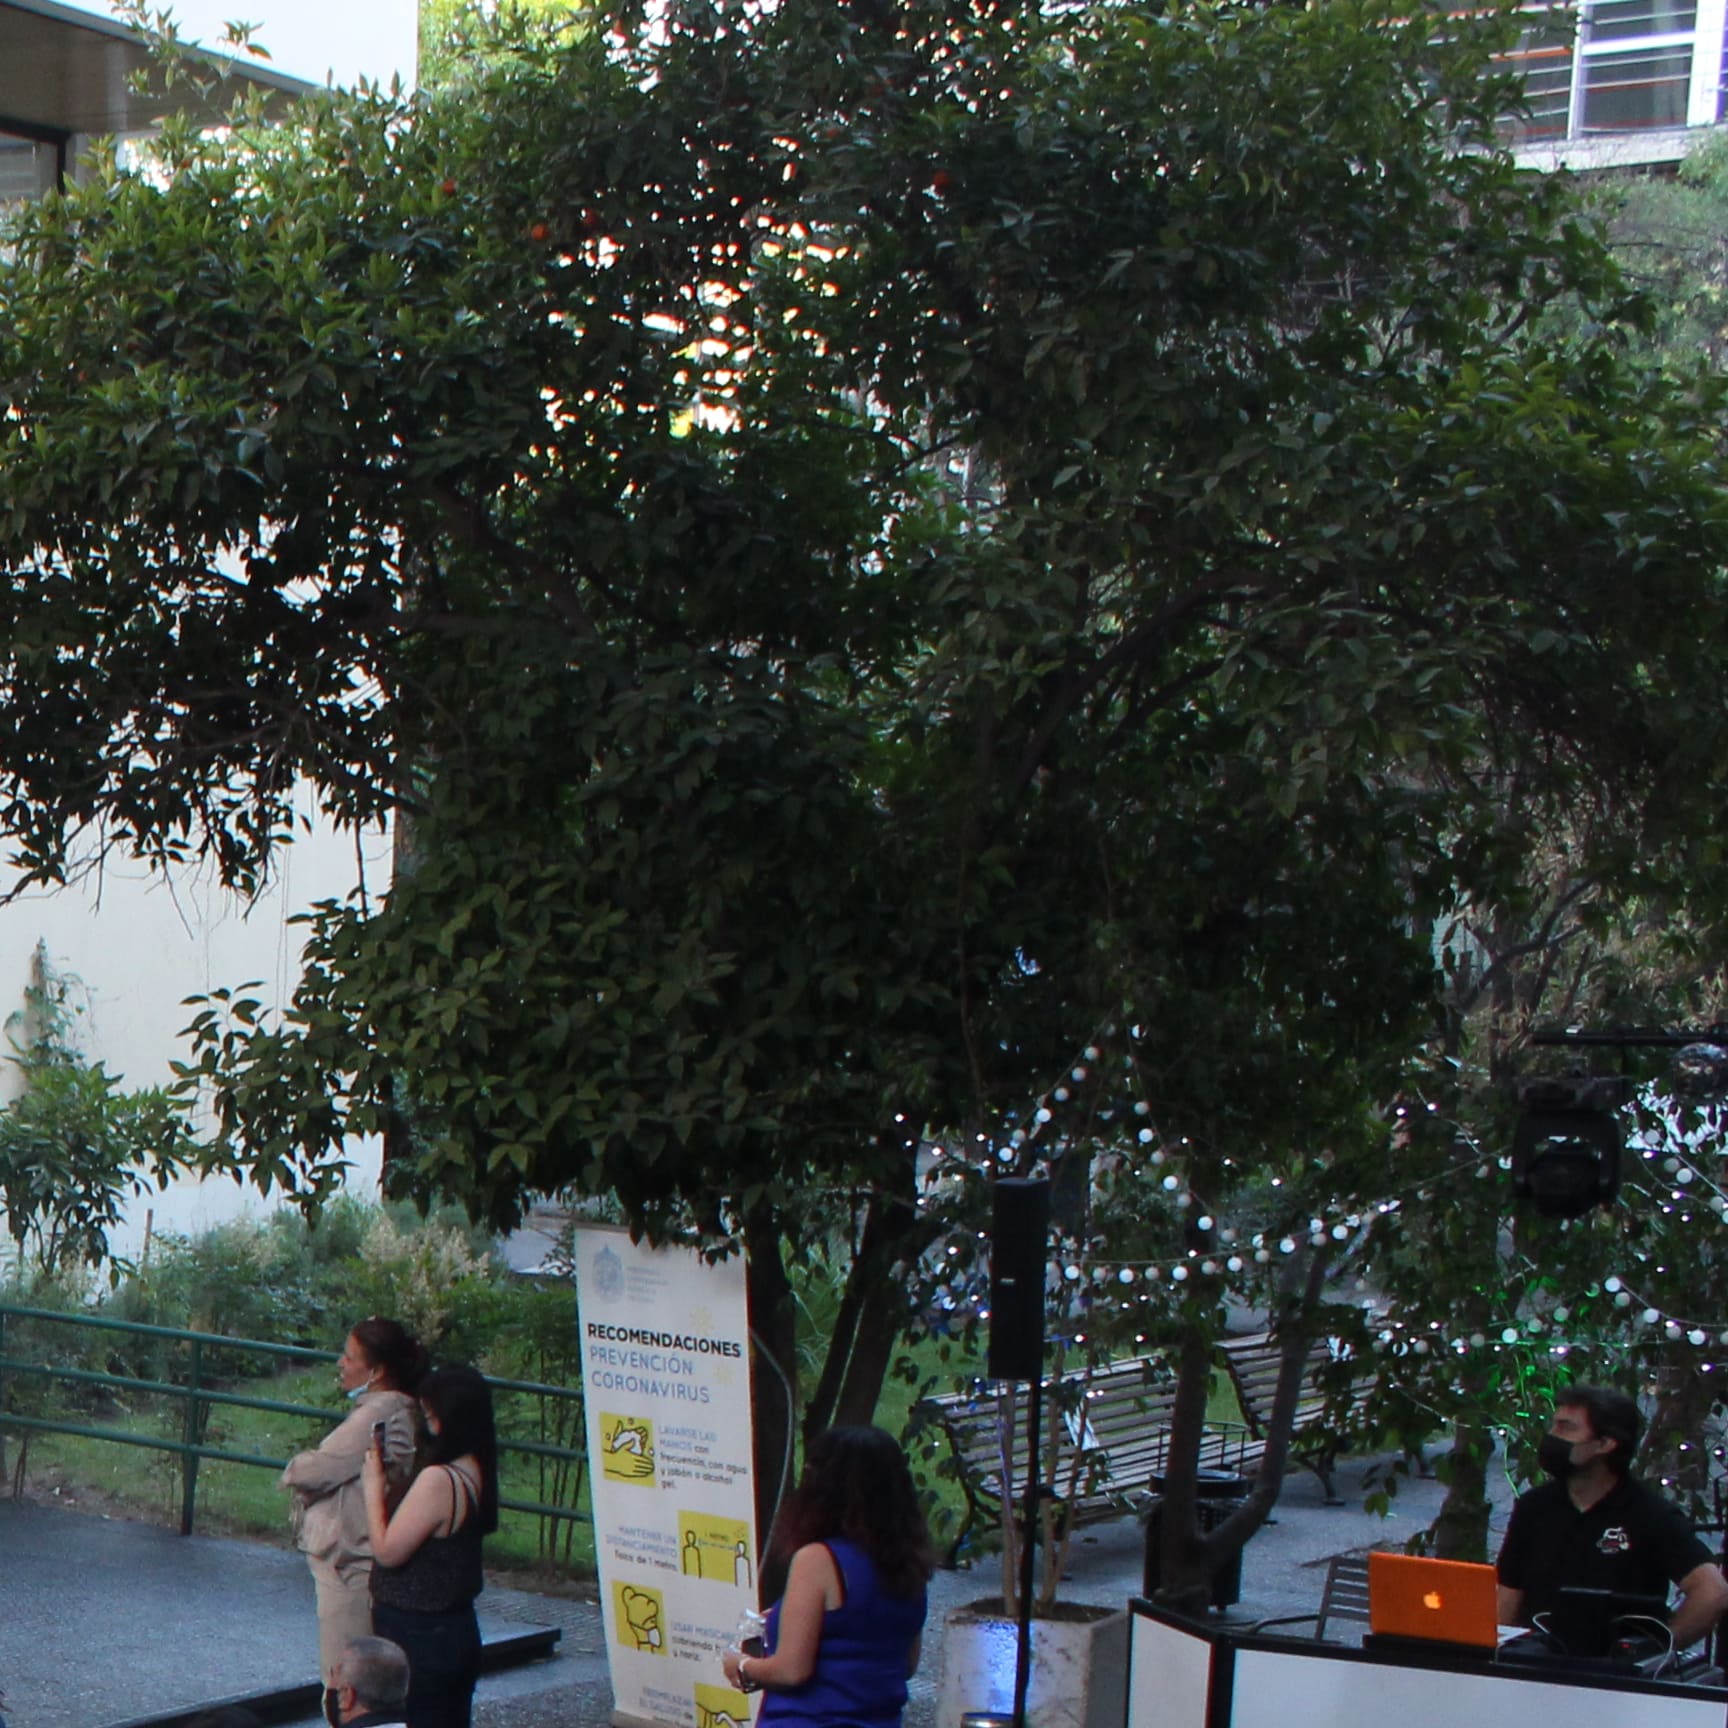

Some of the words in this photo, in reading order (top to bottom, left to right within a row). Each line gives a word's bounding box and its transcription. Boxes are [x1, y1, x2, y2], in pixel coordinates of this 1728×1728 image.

[587, 1323, 742, 1358] RECOMENDACIONES
[590, 1345, 693, 1375] PREVENCIÓN
[591, 1370, 711, 1404] CORONAVIRUS
